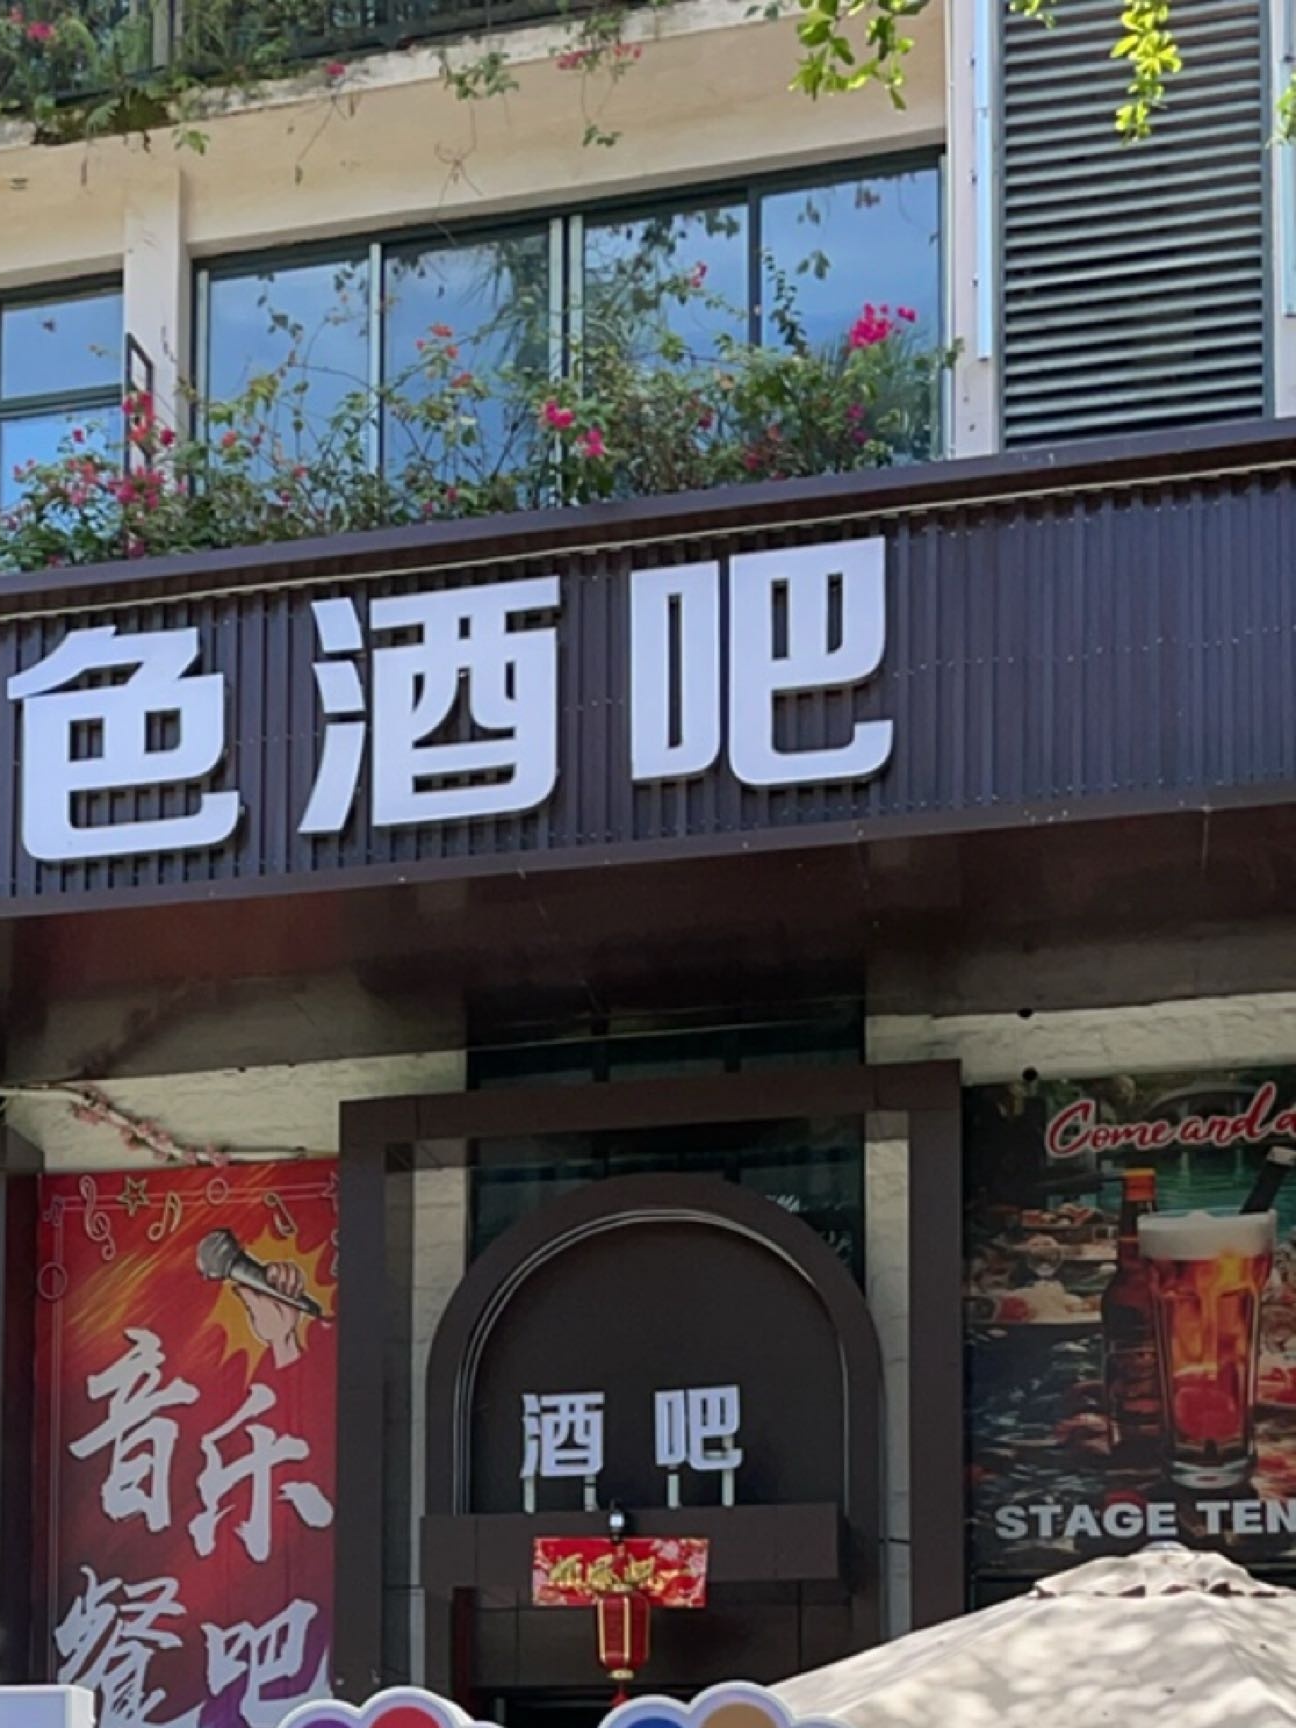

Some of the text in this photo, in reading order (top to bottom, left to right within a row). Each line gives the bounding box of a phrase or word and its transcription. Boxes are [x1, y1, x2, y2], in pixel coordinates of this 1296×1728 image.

[1045, 1099, 1177, 1158] Come
[1179, 1082, 1277, 1147] and
[69, 1328, 334, 1563] 音乐
[520, 1384, 743, 1479] 酒吧
[994, 1502, 1178, 1540] STAGE
